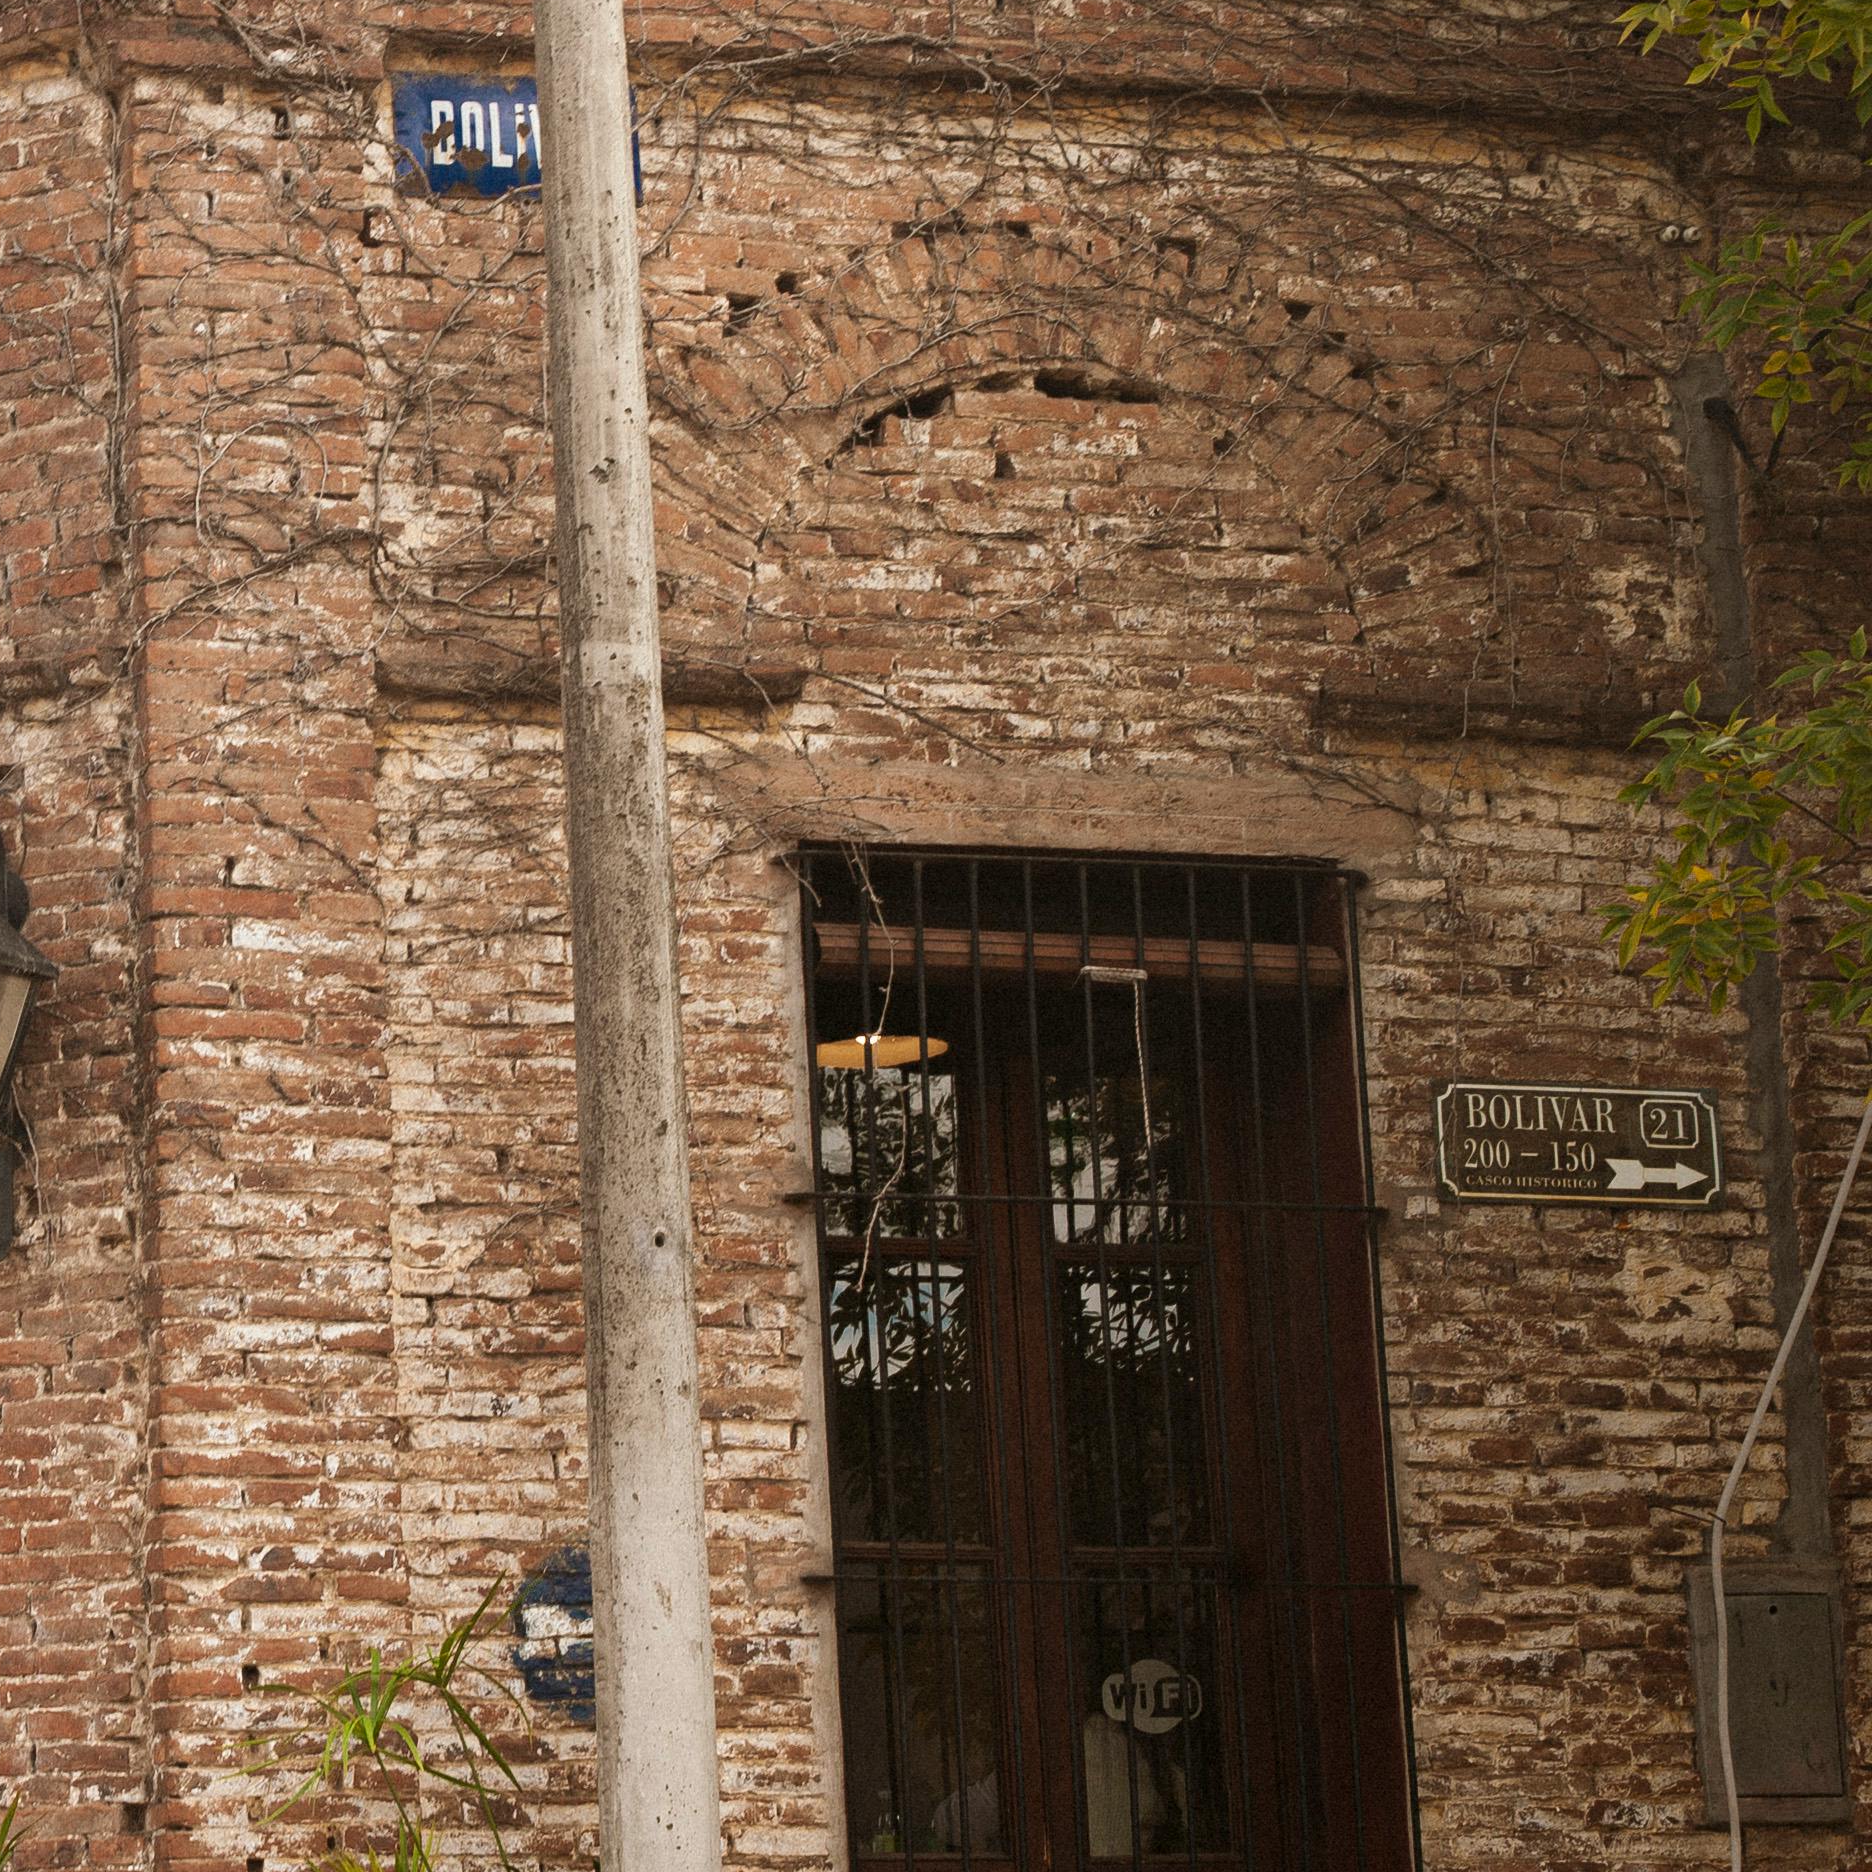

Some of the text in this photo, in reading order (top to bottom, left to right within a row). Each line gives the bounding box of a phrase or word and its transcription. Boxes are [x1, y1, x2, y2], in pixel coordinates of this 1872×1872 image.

[1464, 1092, 1616, 1134] BOLIVAR
[1649, 1106, 1689, 1140] 21
[1464, 1138, 1510, 1169] 200
[1550, 1141, 1596, 1173] 150
[1465, 1175, 1598, 1189] CASCO HISTORICO
